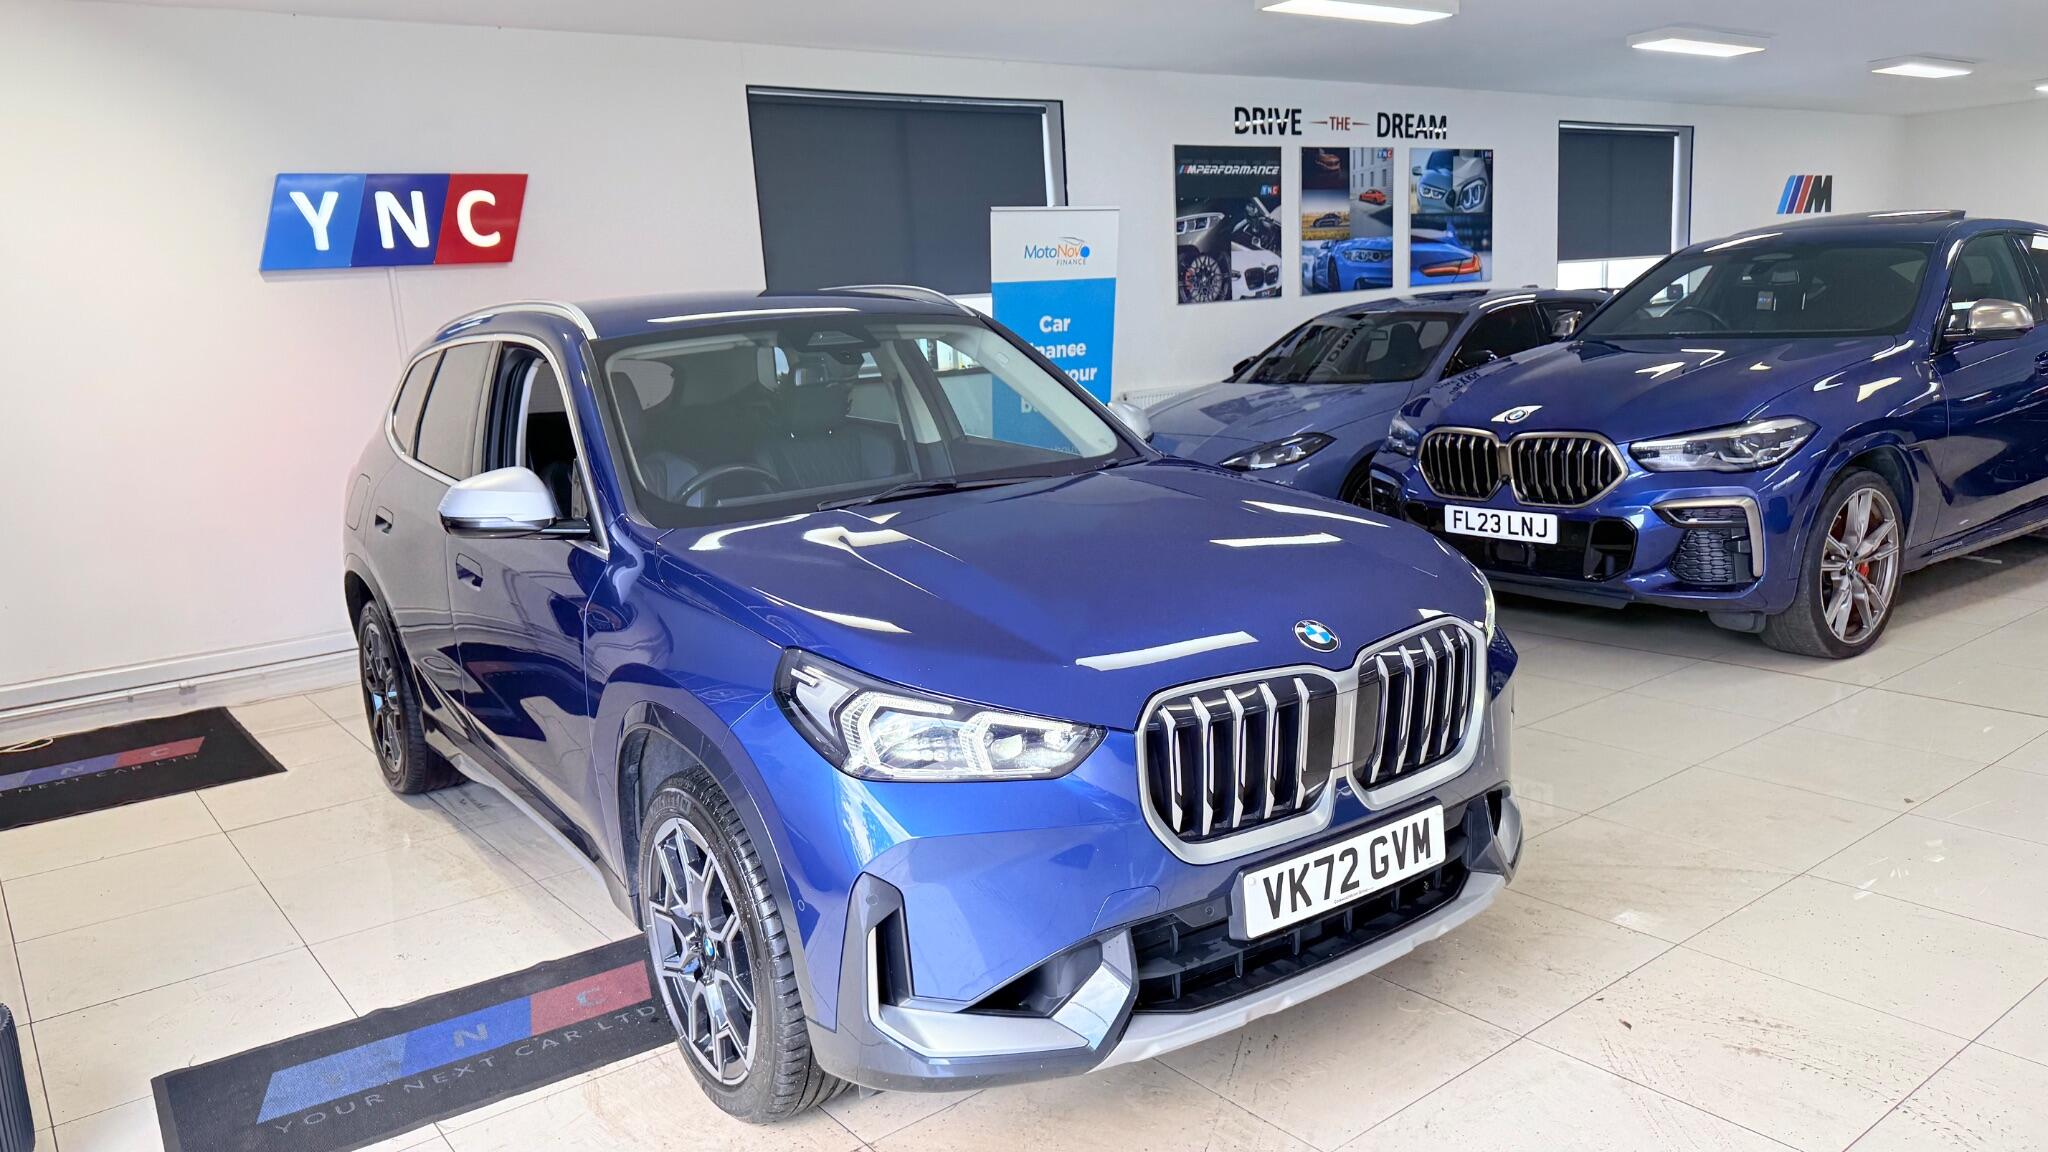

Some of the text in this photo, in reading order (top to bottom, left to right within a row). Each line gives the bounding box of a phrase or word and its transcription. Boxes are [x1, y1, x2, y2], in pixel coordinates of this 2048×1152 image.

[1234, 107, 1447, 140] DRIVE THE DREAM
[289, 189, 501, 251] YNC
[1039, 315, 1072, 333] Car
[1029, 342, 1087, 358] nance
[1065, 367, 1098, 382] our
[1453, 510, 1548, 538] FL23 LNJ
[18, 776, 81, 793] NEXT
[96, 764, 143, 778] CAR
[1263, 817, 1431, 920] VK72 GVM
[275, 1006, 656, 1134] YOUR NEXT CAR LTD
